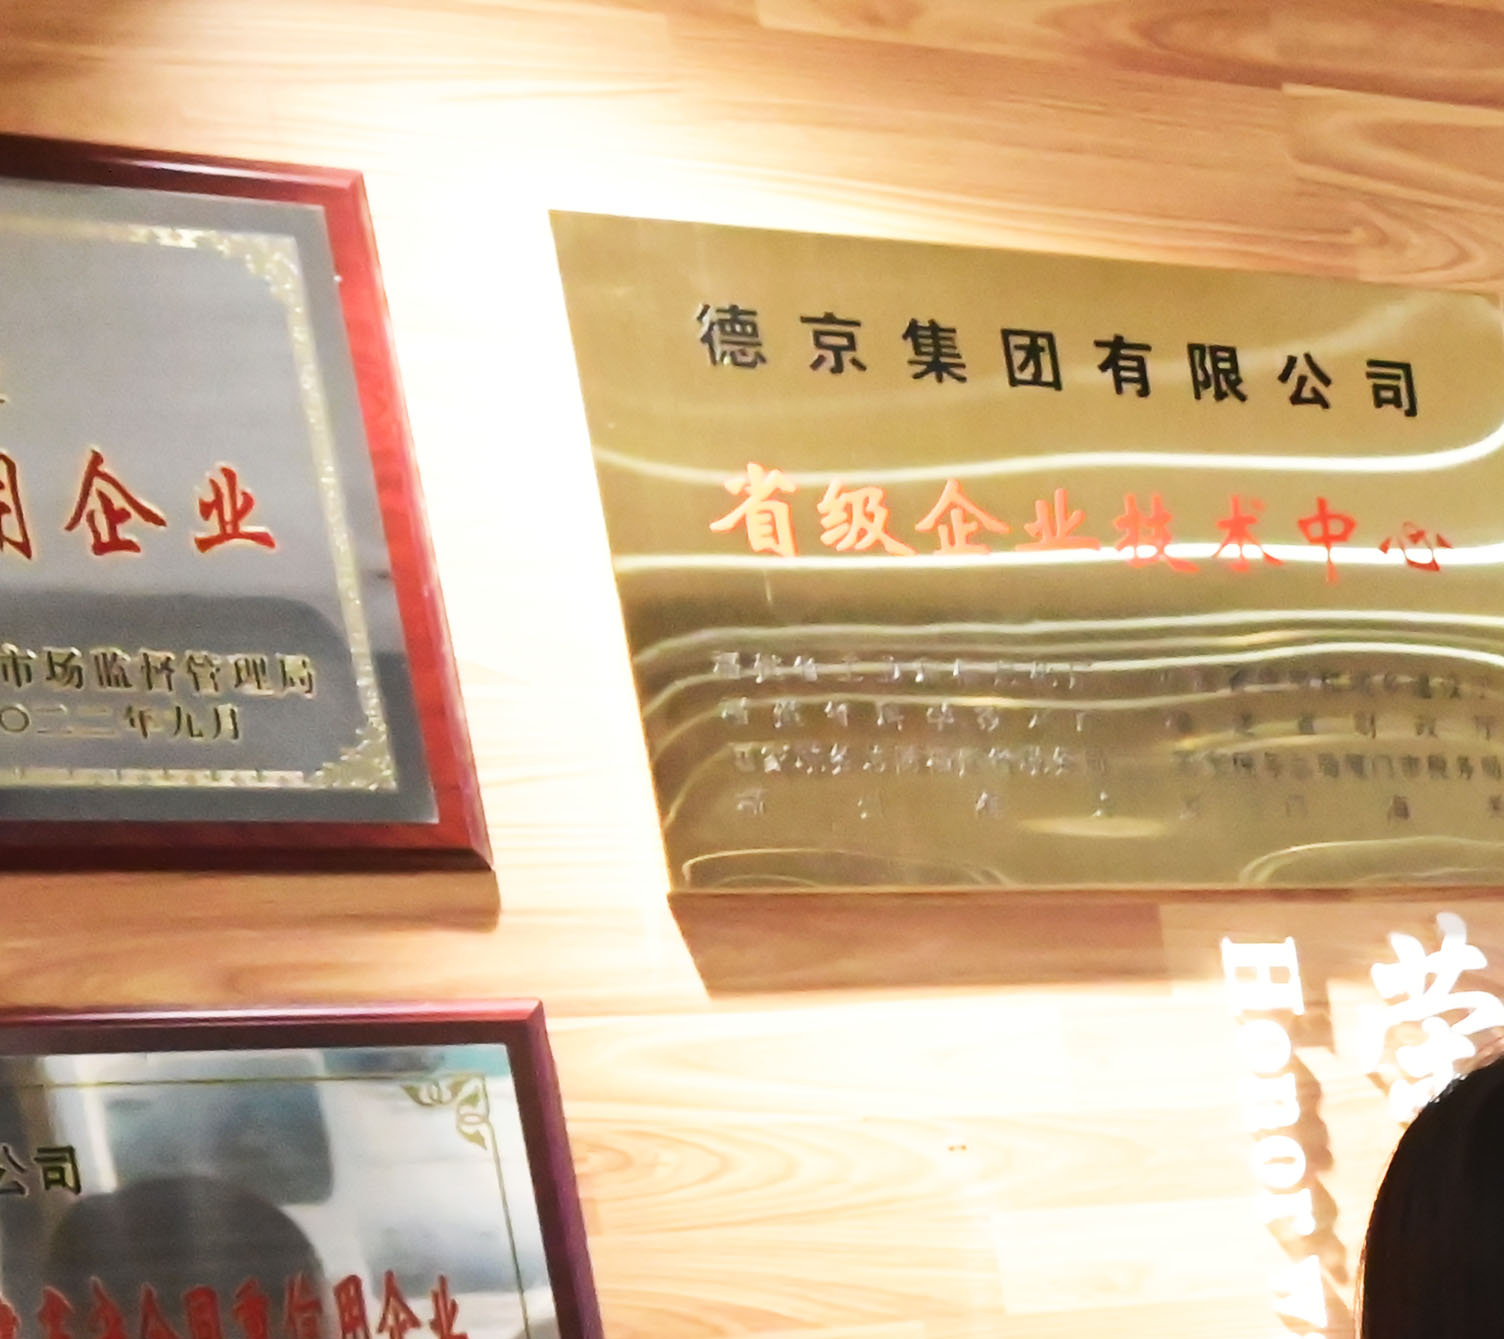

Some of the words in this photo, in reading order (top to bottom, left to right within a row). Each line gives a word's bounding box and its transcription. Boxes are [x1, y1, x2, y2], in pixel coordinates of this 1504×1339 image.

[695, 301, 1419, 417] 德京集团有限公司
[709, 461, 1454, 584] 省级企业技术中心
[0, 646, 313, 698] 市场监督管理局
